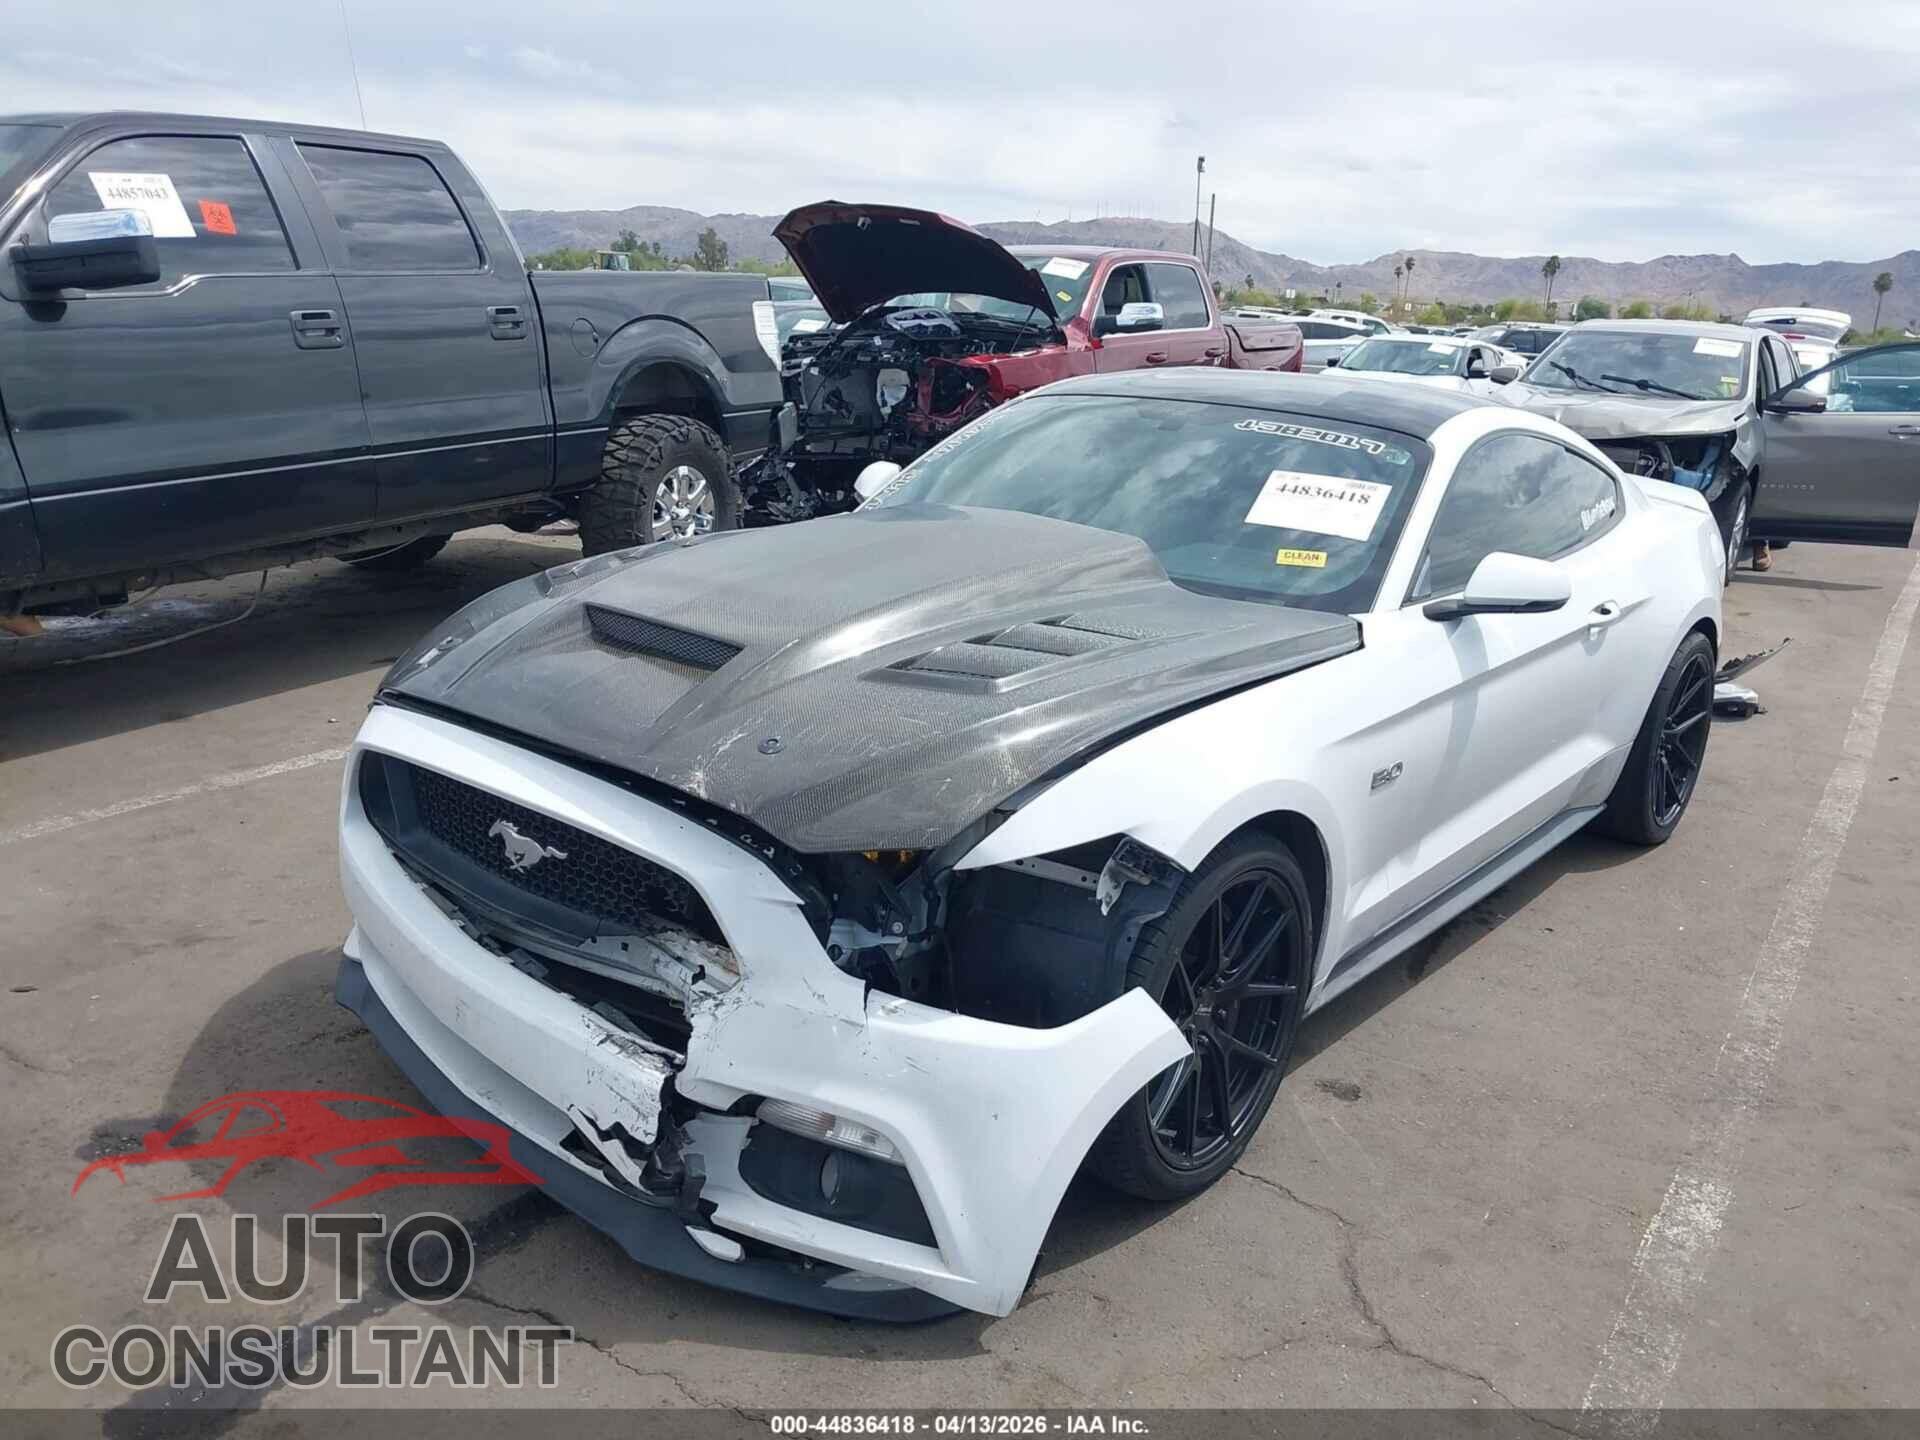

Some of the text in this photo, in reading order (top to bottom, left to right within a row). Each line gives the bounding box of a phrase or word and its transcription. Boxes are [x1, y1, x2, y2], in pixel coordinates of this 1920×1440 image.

[107, 187, 169, 200] 44857043
[1275, 482, 1371, 505] 44836418
[1283, 551, 1320, 561] CLEAN
